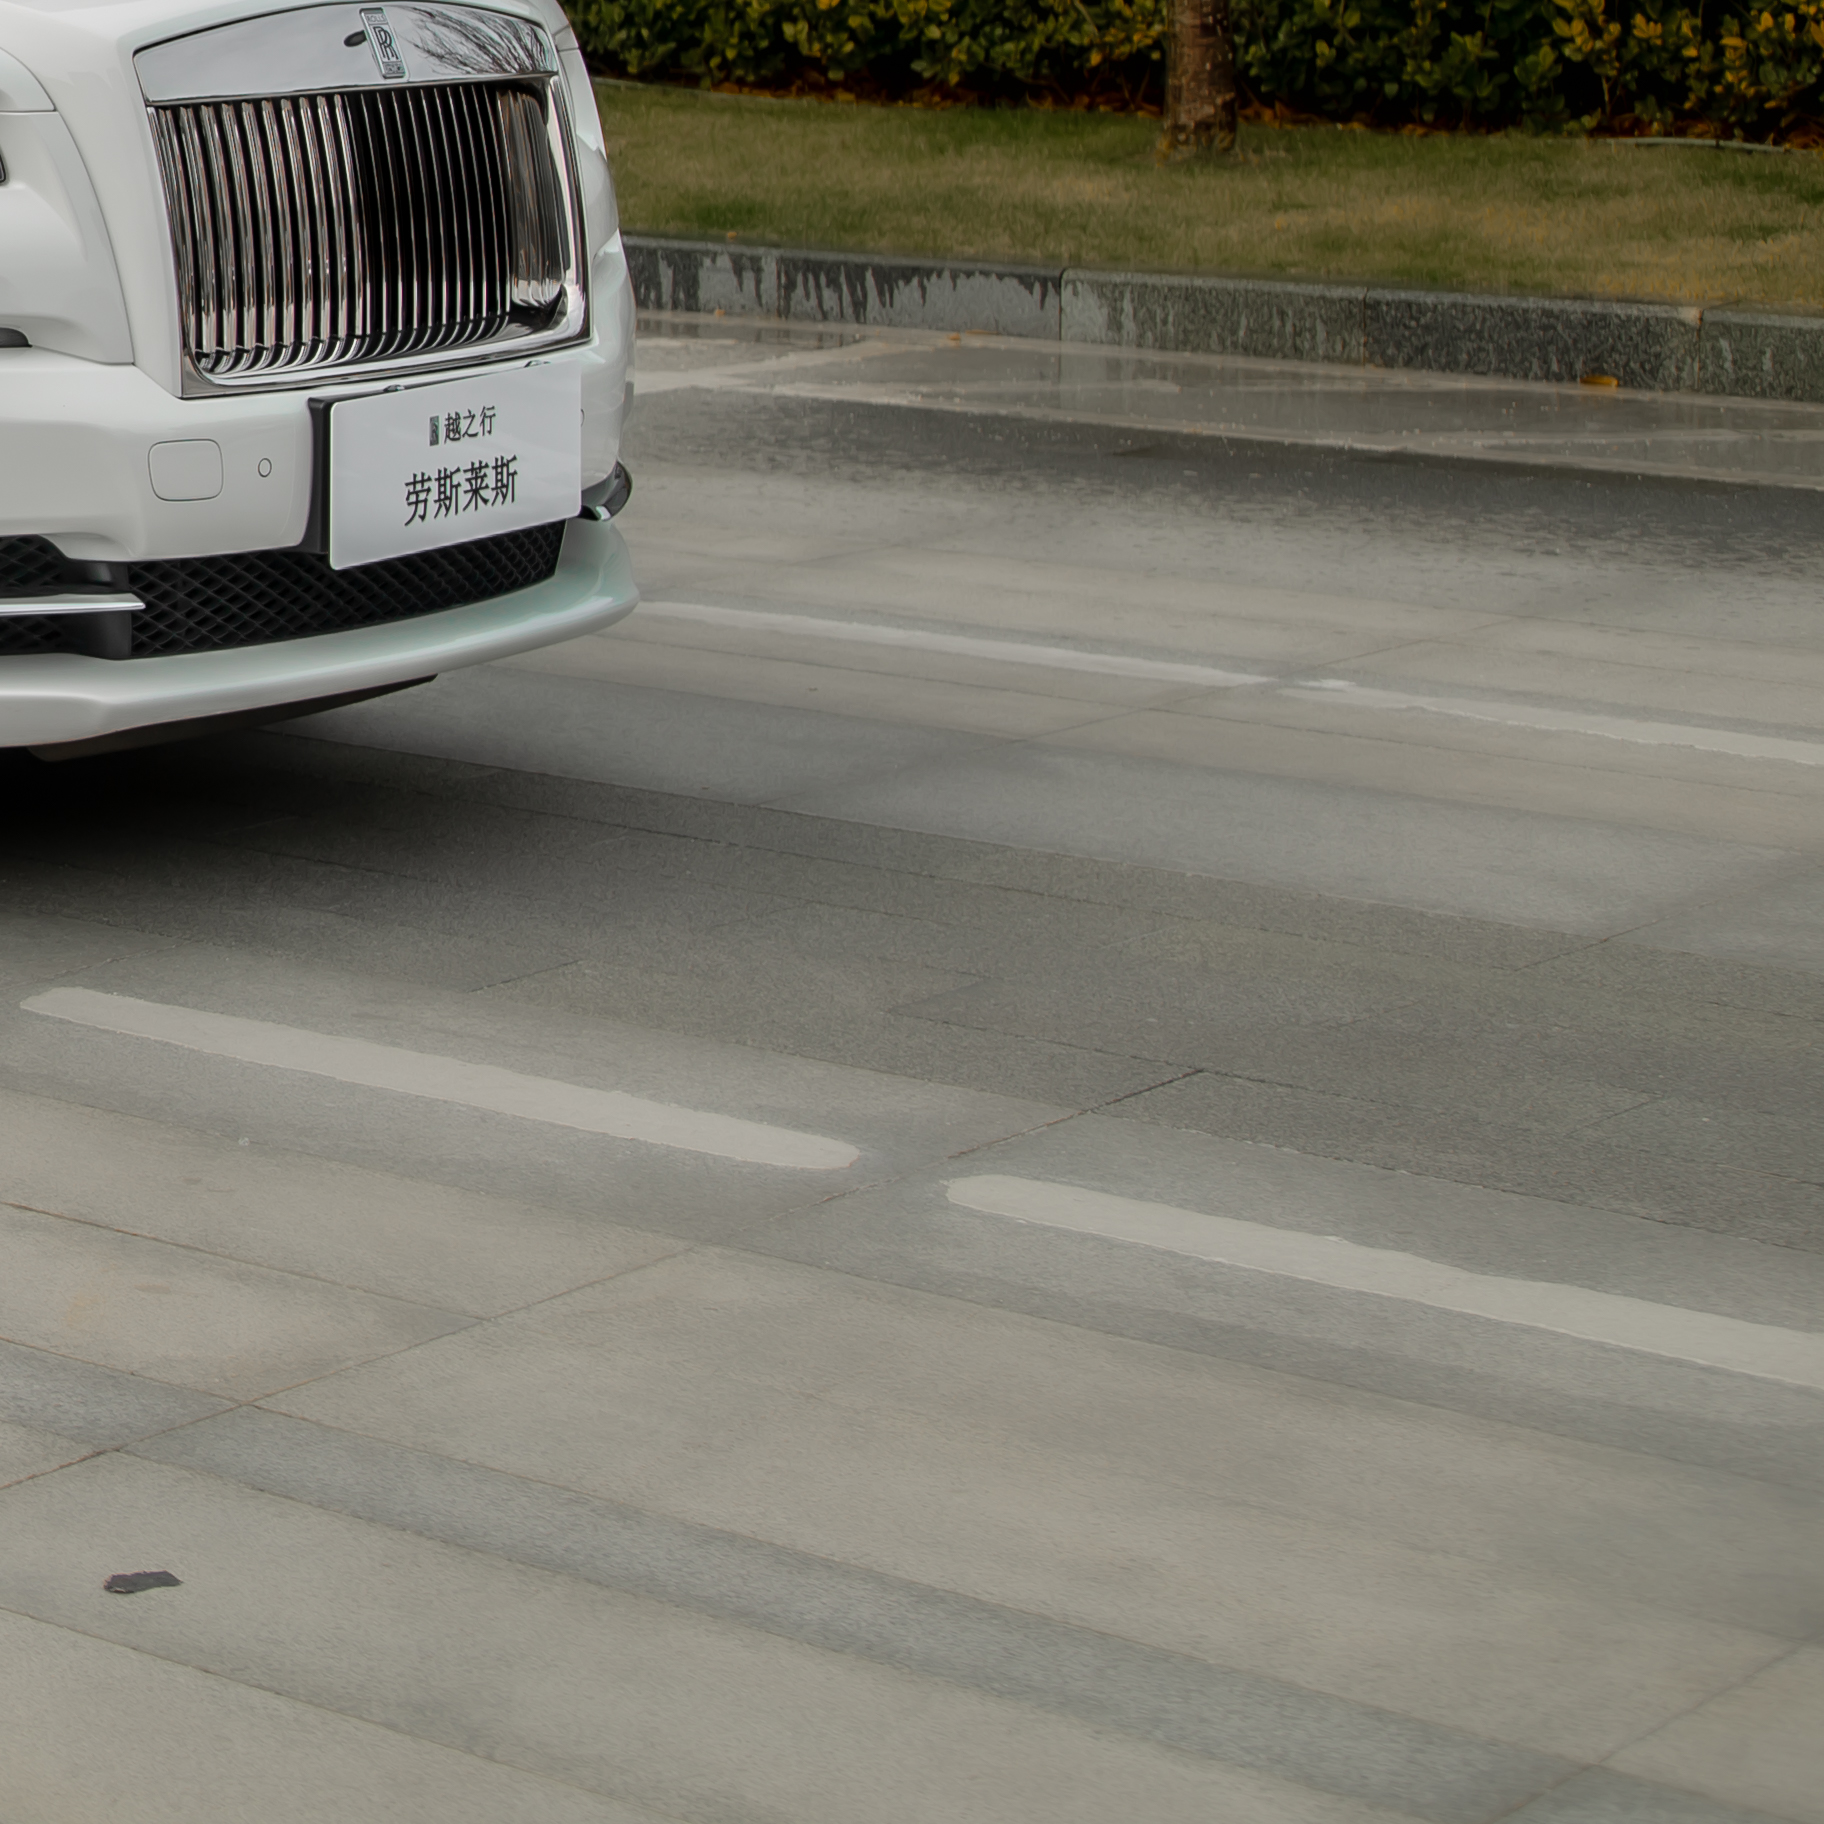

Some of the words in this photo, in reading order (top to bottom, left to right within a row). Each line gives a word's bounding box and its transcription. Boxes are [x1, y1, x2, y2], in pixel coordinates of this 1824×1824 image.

[443, 405, 496, 444] 越之行
[404, 454, 518, 526] 劳斯莱斯
